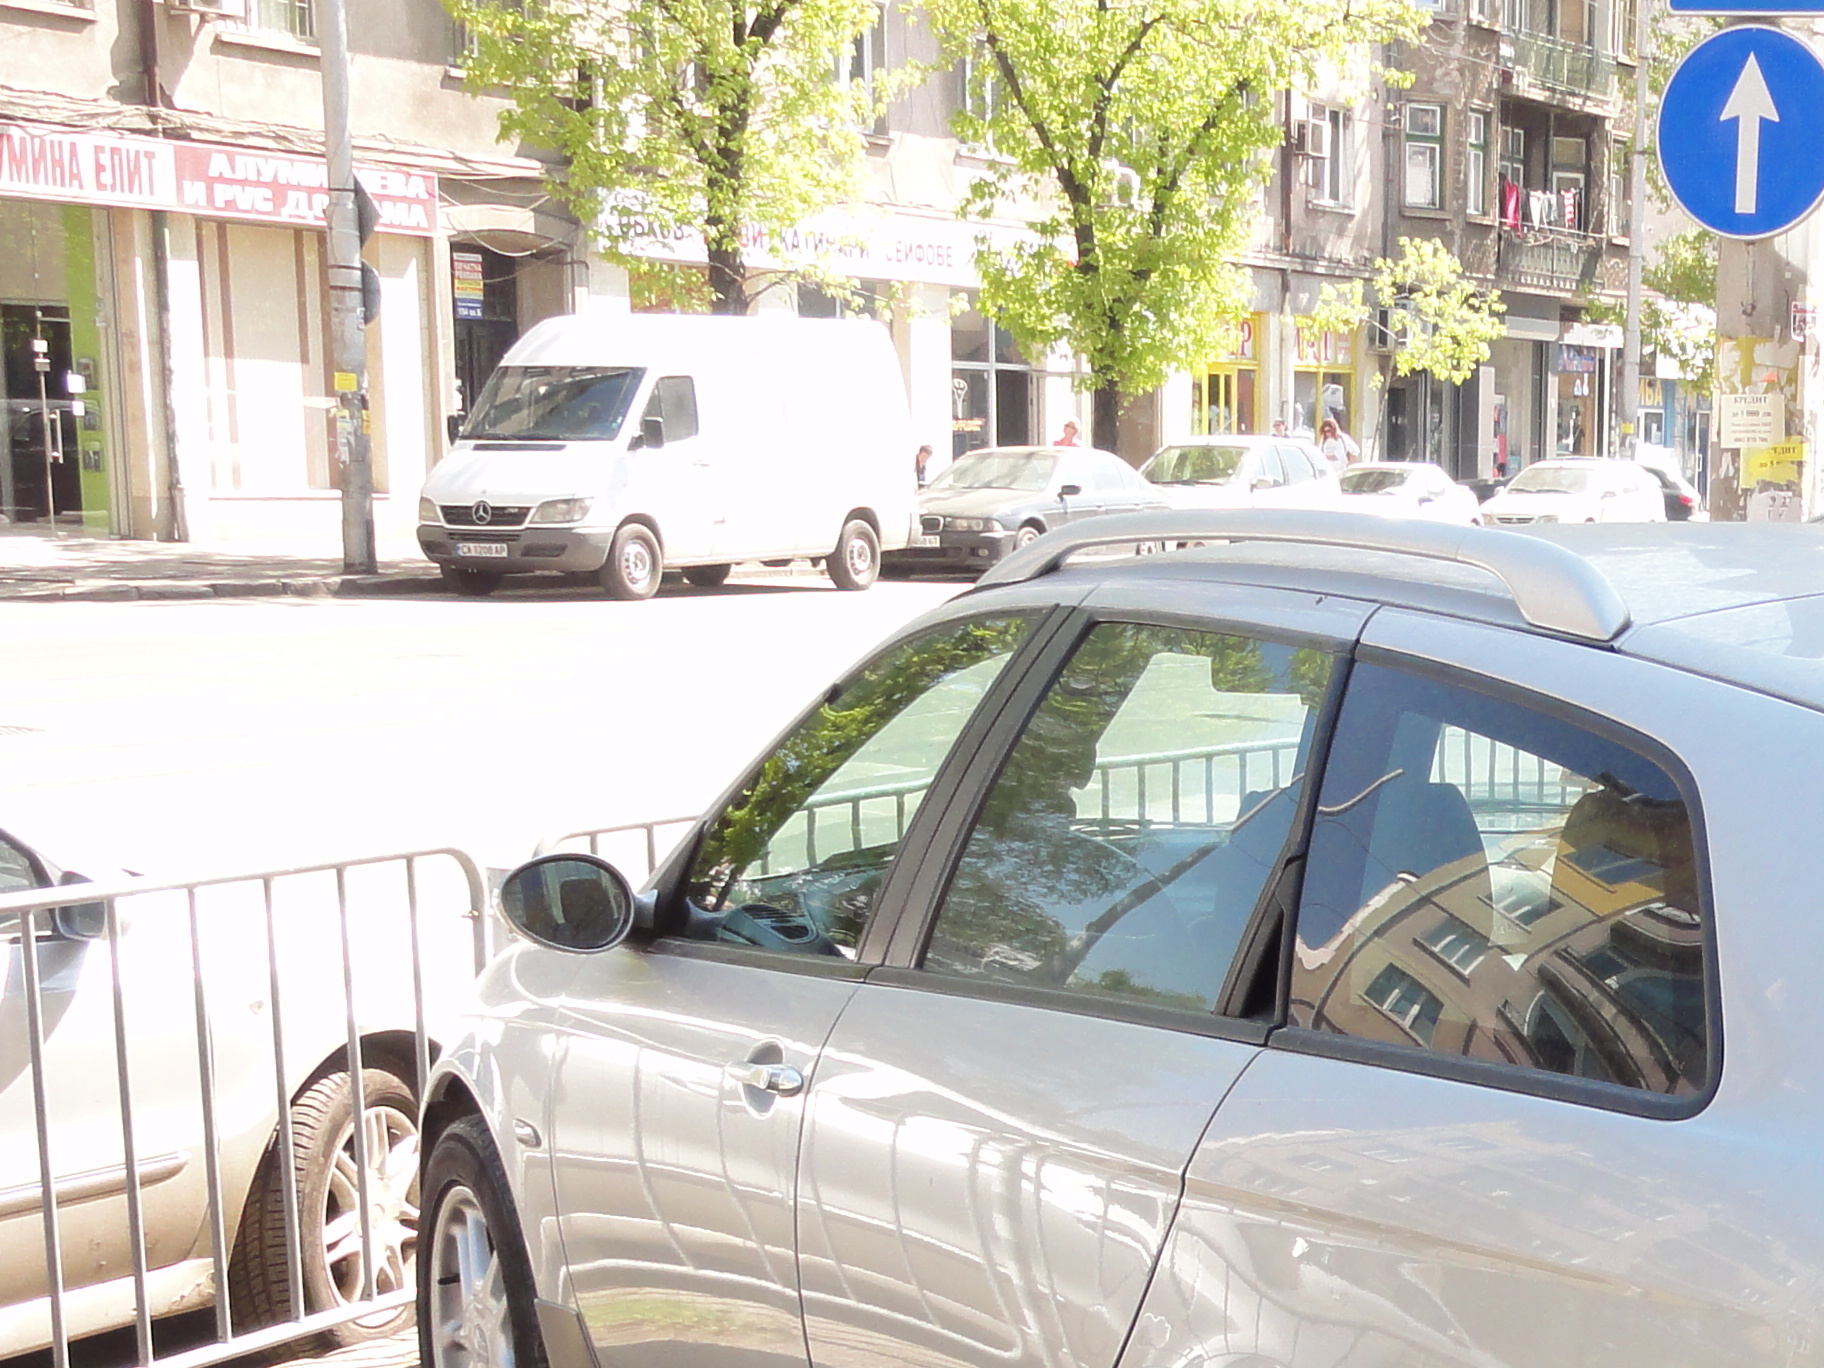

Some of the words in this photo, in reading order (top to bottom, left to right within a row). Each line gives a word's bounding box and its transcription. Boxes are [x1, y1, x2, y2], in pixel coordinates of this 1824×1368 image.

[94, 145, 156, 196] ЕЛИТ
[183, 181, 206, 207] И
[213, 183, 273, 212] PVC
